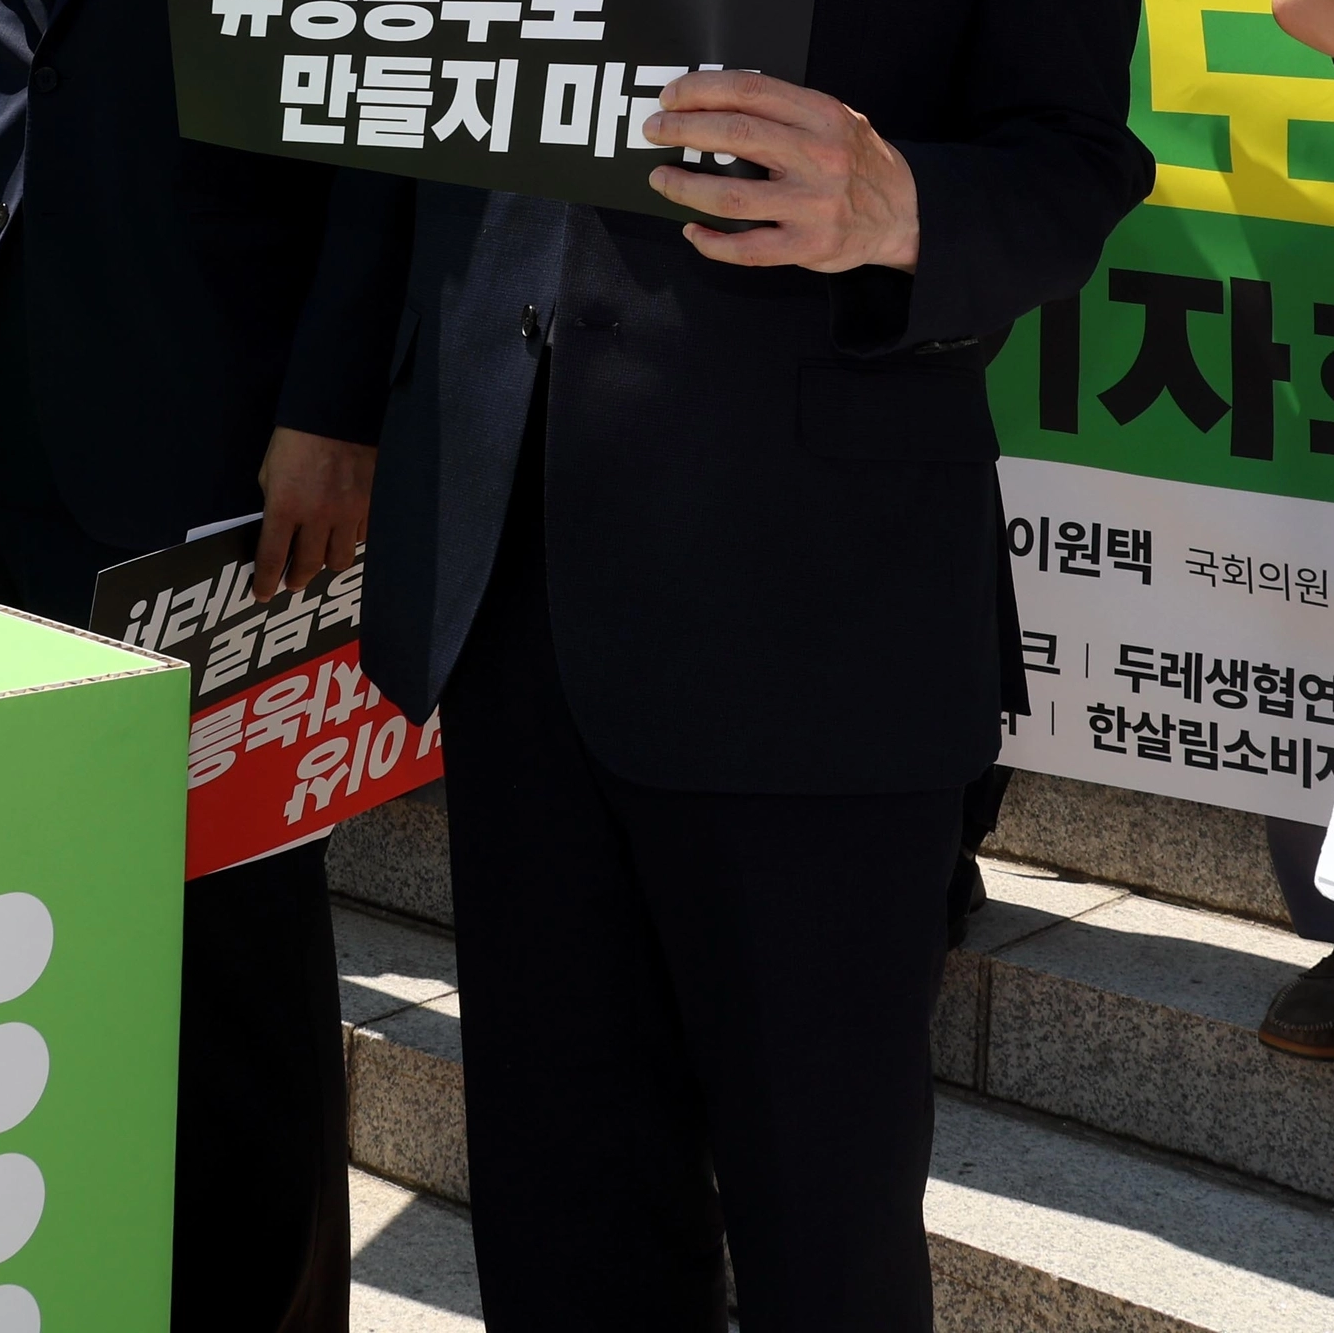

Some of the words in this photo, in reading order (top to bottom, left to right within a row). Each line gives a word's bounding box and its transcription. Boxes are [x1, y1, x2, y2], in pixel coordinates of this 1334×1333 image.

[279, 55, 519, 152] 만들지
[1007, 517, 1154, 587] 이원택
[1185, 548, 1330, 608] 국회의원
